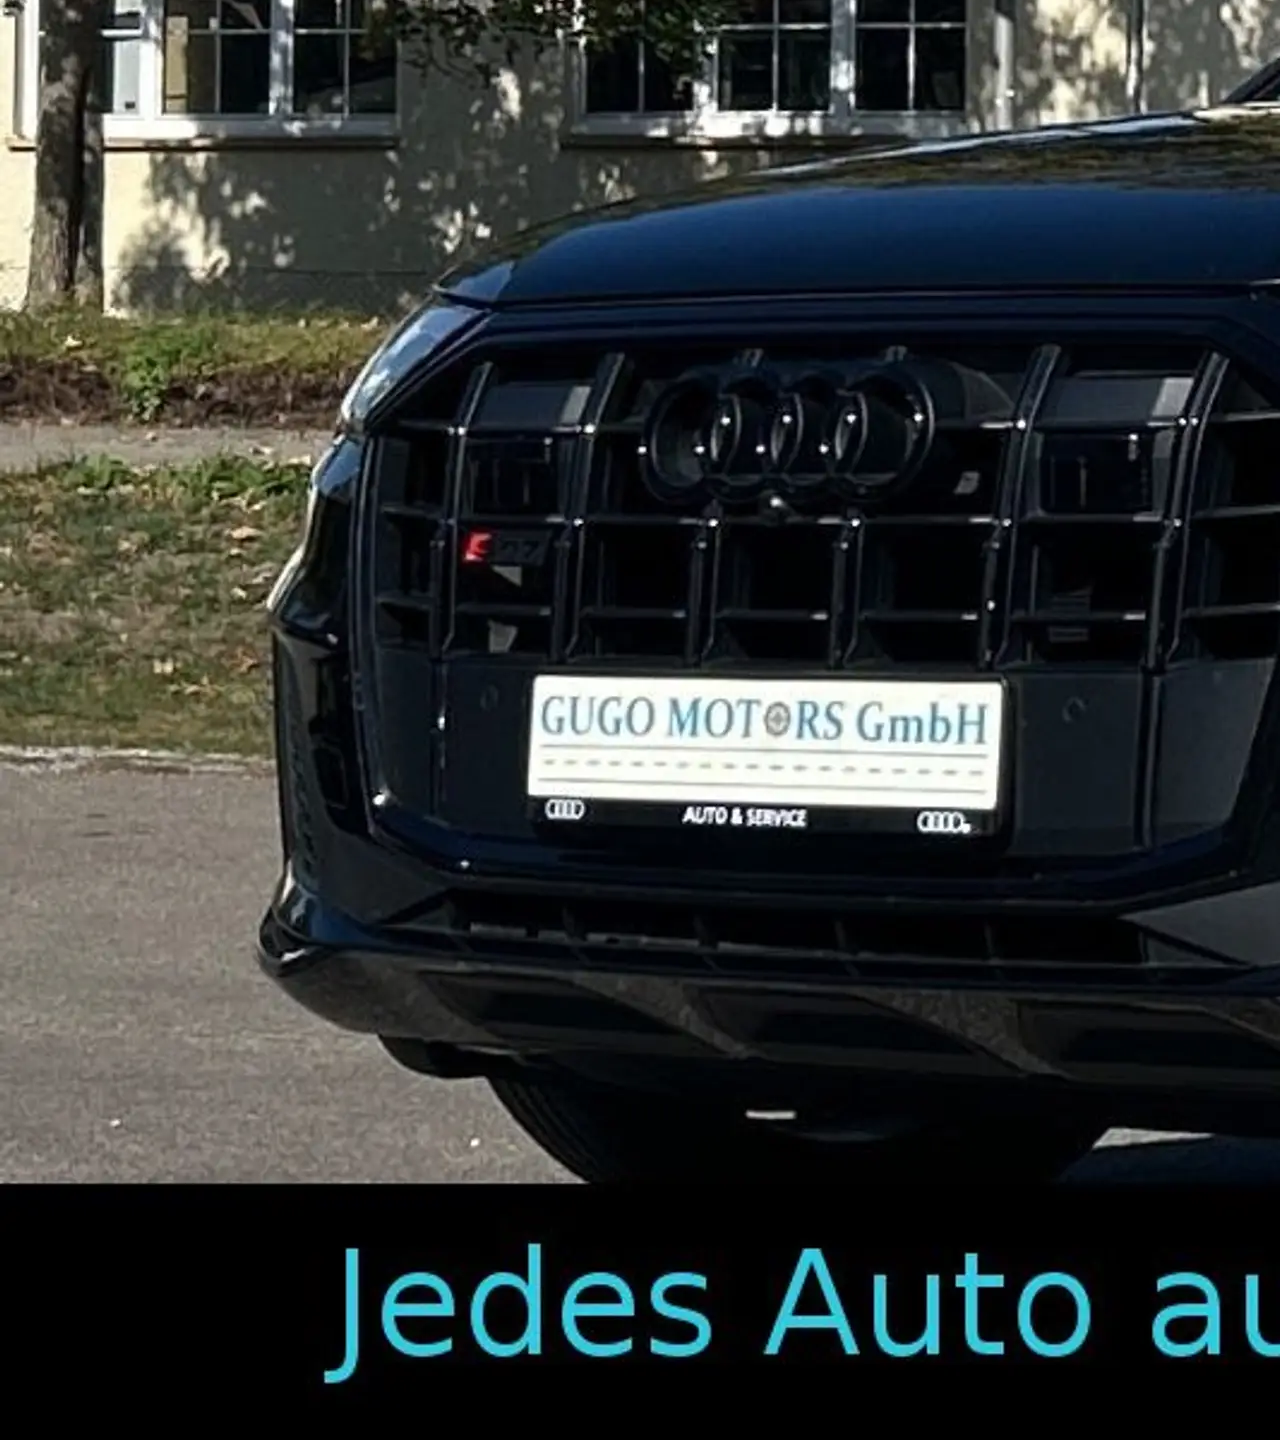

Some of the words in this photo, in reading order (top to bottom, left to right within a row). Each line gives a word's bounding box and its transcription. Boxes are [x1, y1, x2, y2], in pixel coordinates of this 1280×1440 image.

[541, 695, 655, 737] GUGO
[666, 697, 845, 741] MOTORS
[856, 700, 988, 745] GmbH
[681, 806, 728, 825] AUTO
[730, 807, 743, 826] &
[746, 808, 808, 828] SERVICE
